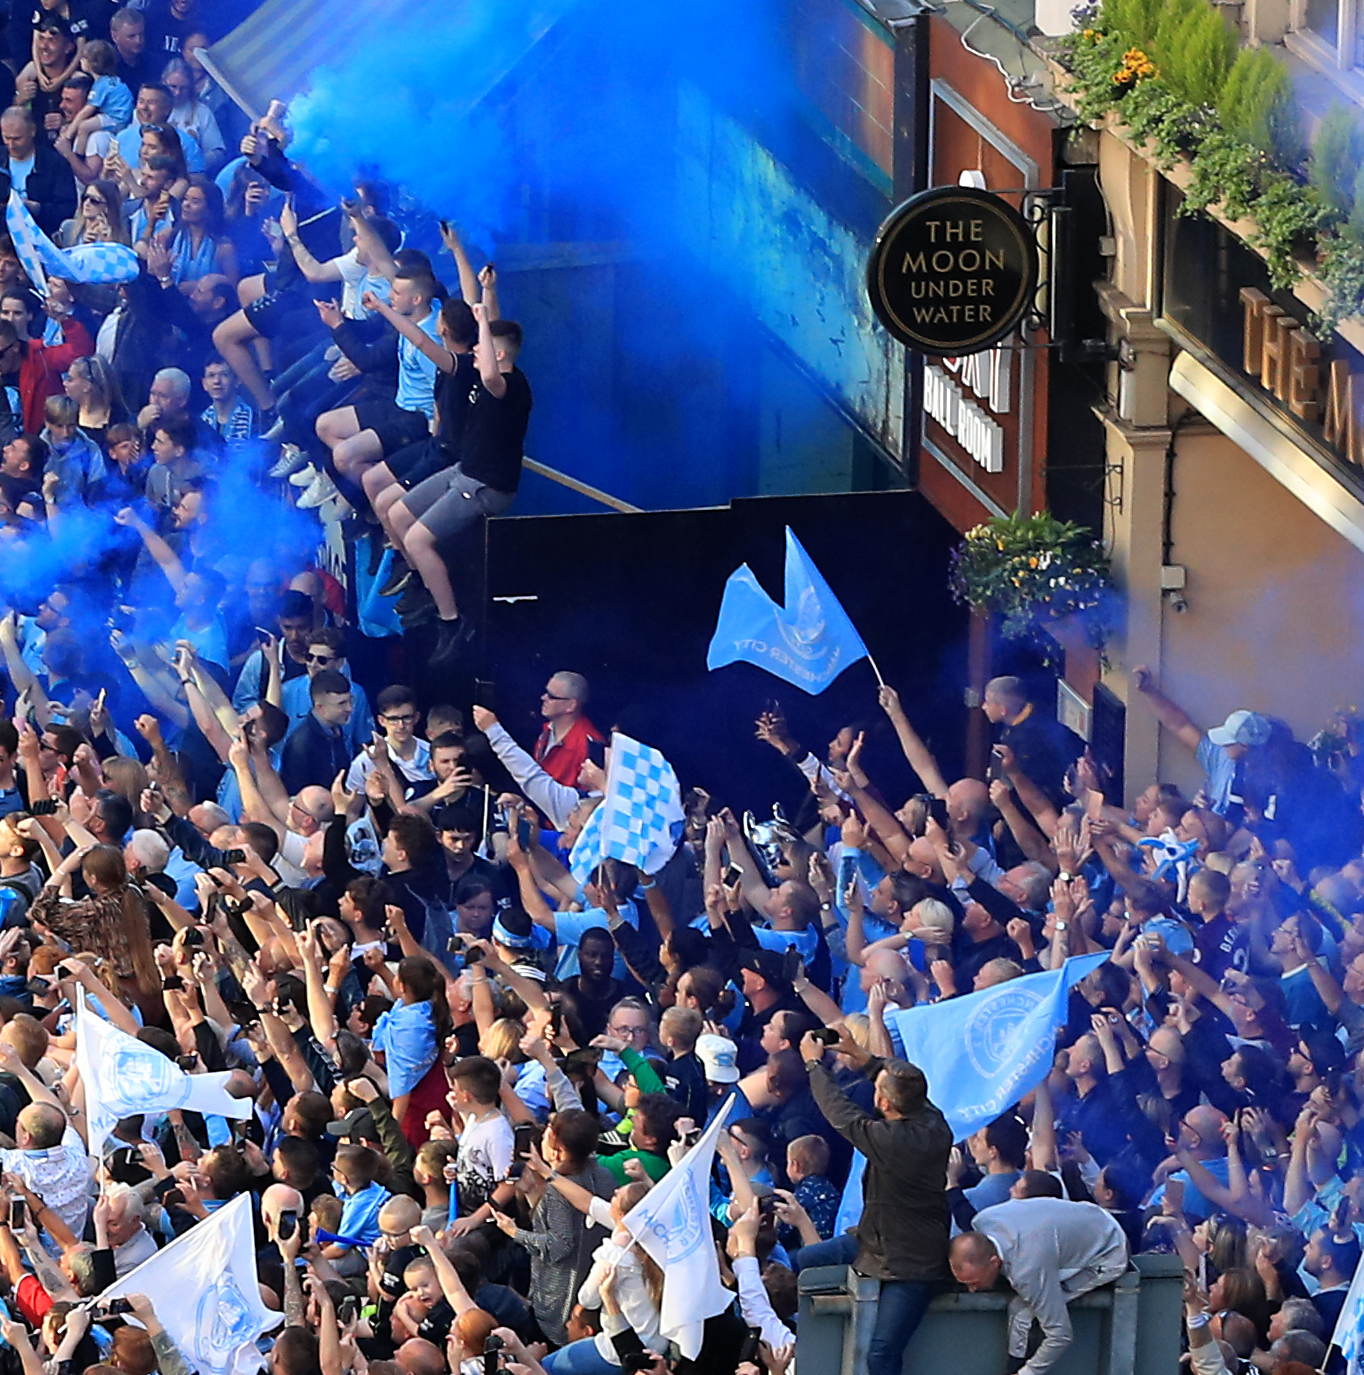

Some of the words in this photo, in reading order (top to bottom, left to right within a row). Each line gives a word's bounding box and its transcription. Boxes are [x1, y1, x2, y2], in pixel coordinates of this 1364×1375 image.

[926, 220, 983, 243] THE
[901, 248, 1006, 274] MOON
[910, 278, 996, 299] UNDER
[913, 304, 993, 324] WATER
[1238, 286, 1320, 421] THE
[1323, 359, 1364, 469] M
[924, 364, 962, 436] BALL
[958, 398, 1003, 472] ROOM
